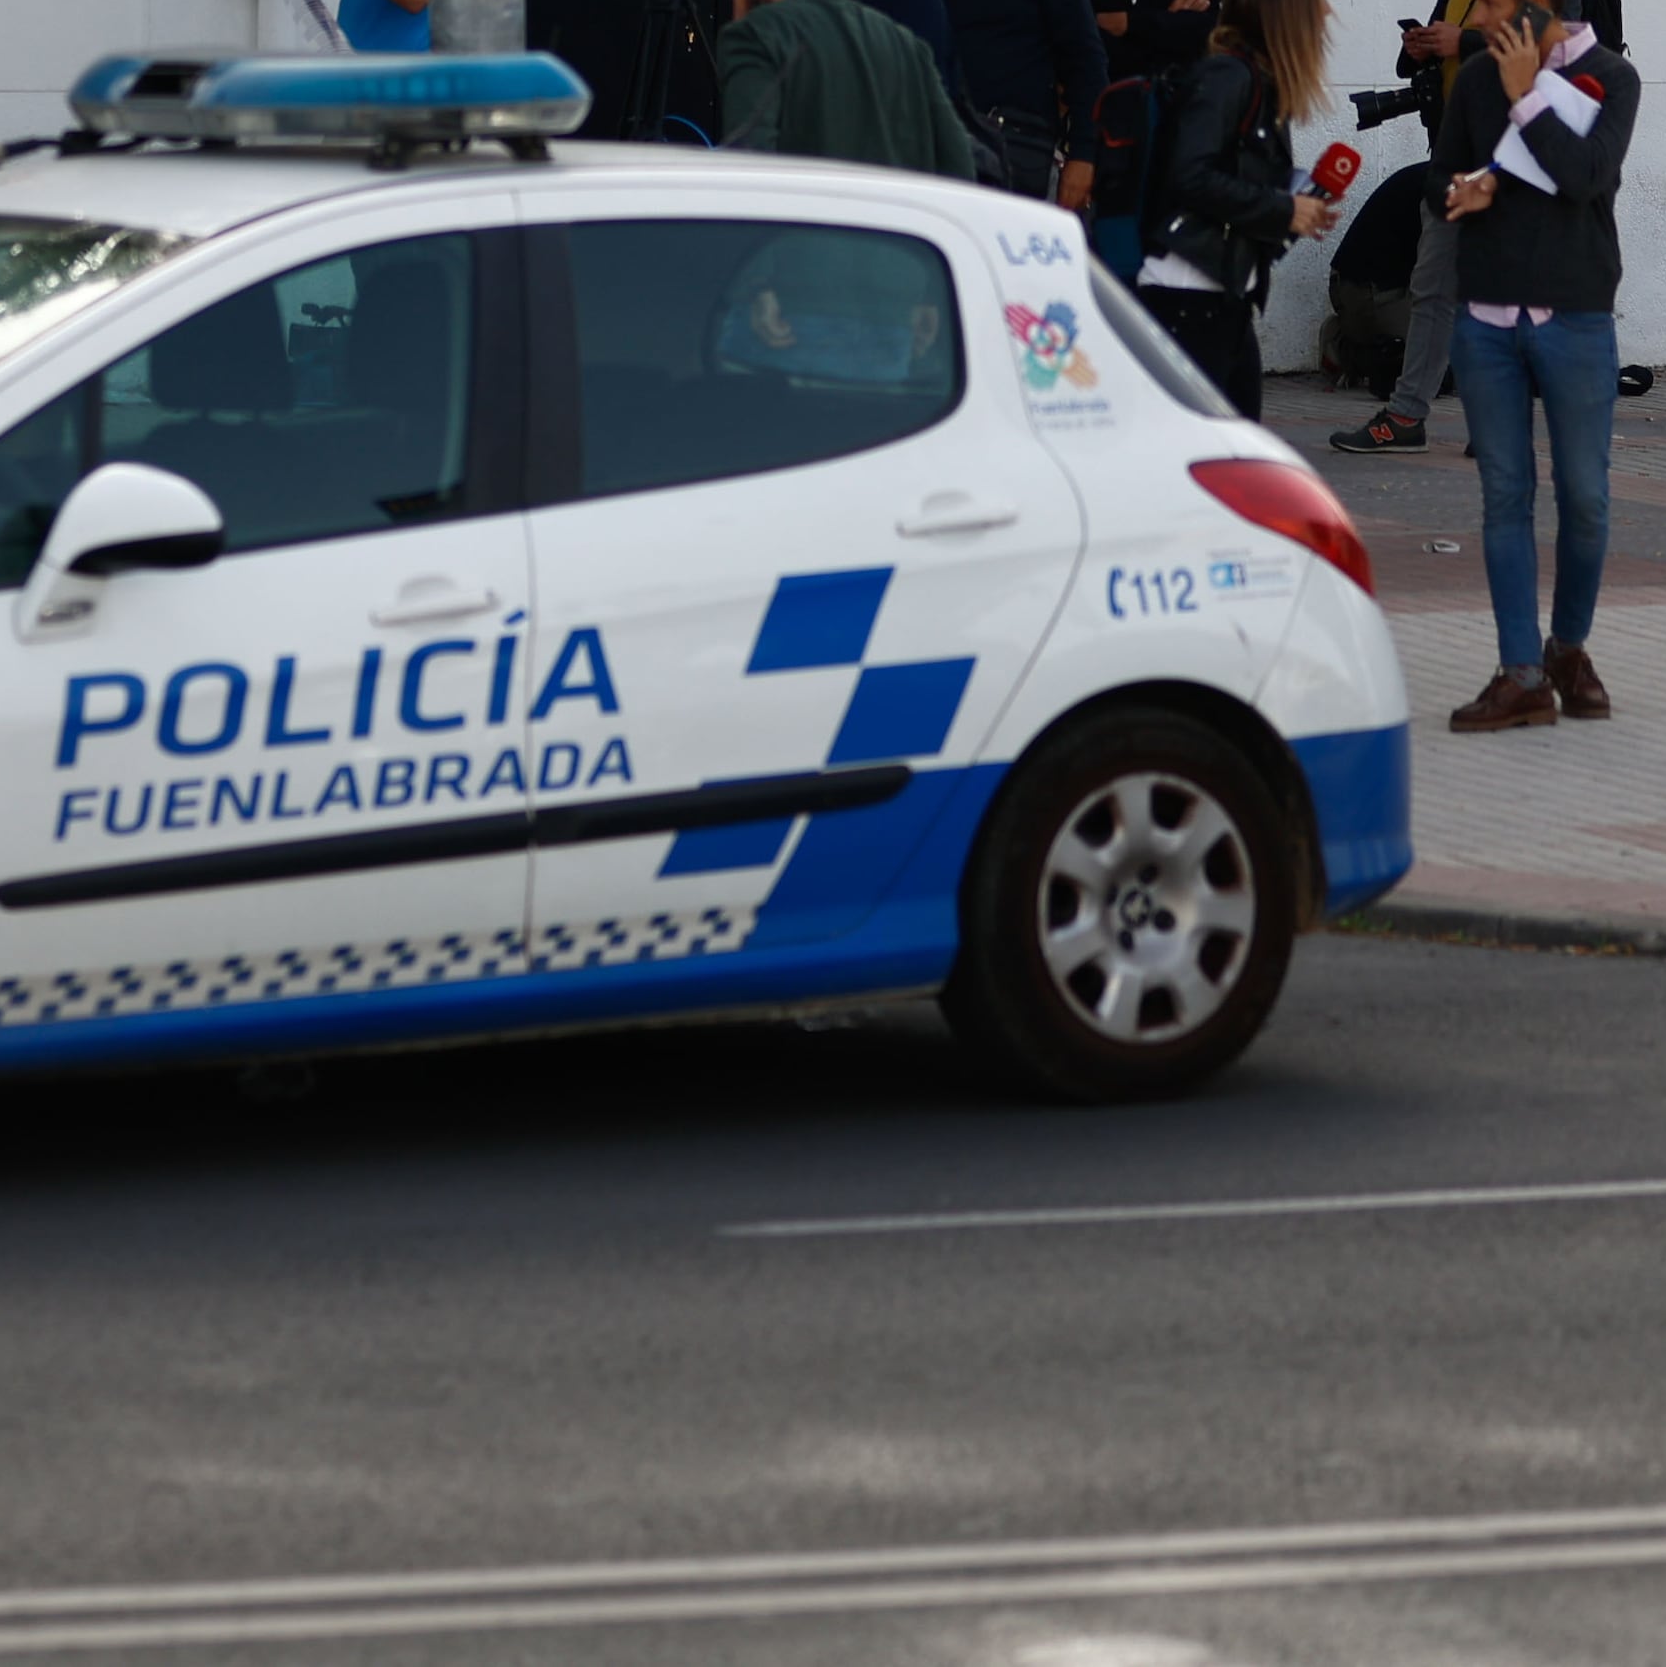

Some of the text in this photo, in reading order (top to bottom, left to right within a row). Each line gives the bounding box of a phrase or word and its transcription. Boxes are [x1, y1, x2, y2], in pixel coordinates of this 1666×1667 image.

[1131, 567, 1198, 616] 112
[54, 610, 621, 769] POLICÍA
[55, 738, 635, 842] FUENLABRADA
